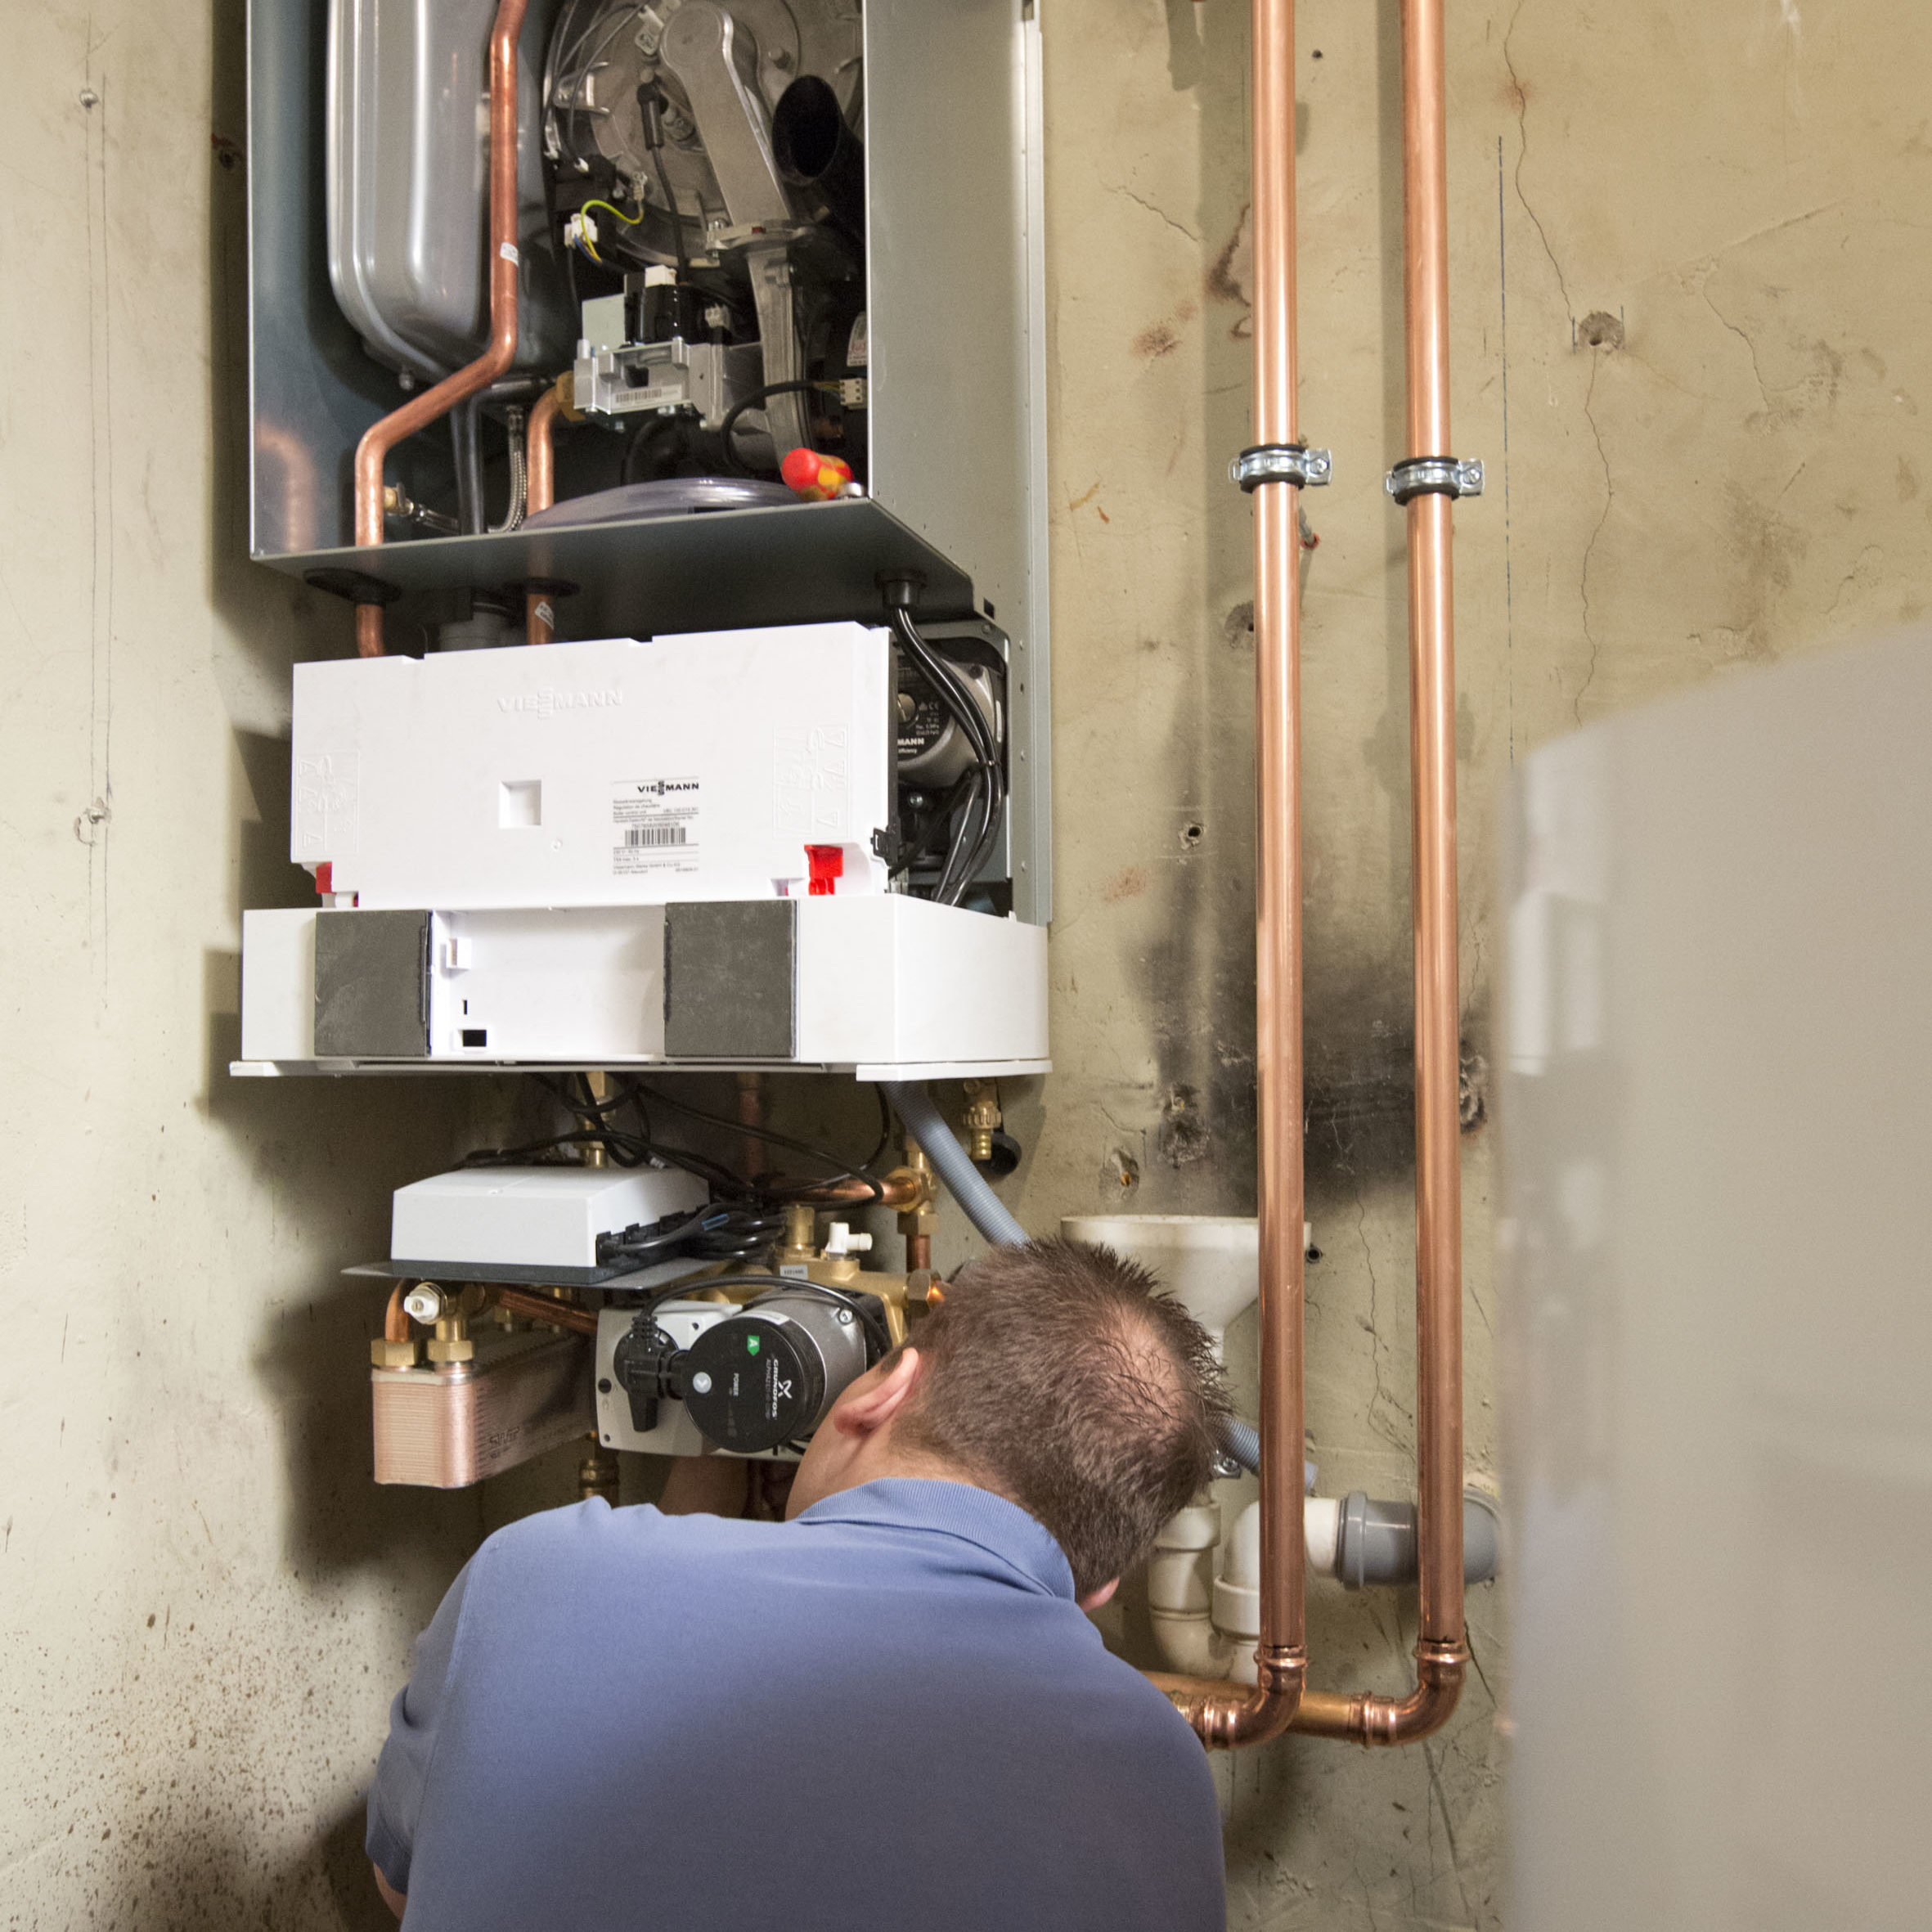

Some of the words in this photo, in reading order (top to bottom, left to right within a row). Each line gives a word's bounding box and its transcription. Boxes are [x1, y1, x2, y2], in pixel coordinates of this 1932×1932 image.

[496, 687, 622, 721] VIESSMANN
[637, 780, 699, 795] VIESSMANN
[749, 1338, 758, 1347] A
